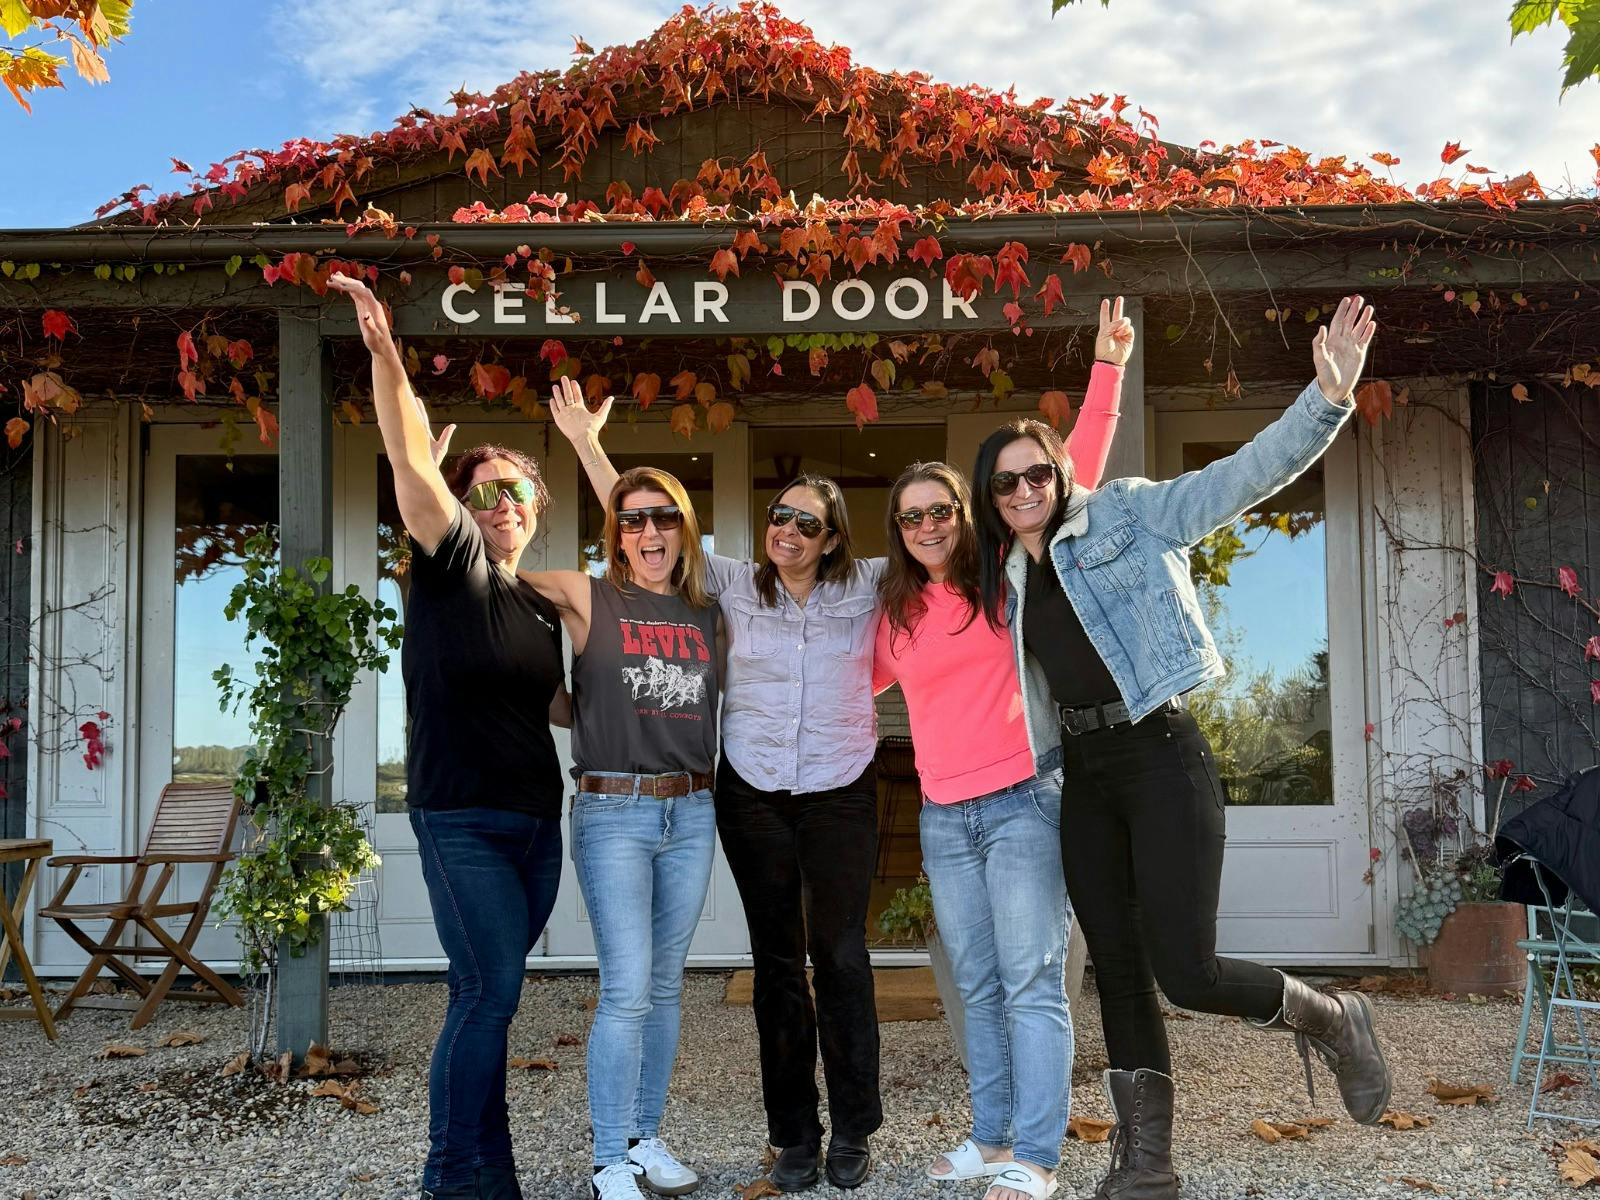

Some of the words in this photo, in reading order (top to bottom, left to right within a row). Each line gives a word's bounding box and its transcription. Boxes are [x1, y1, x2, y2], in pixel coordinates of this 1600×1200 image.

[441, 281, 730, 324] CELLAR
[783, 277, 979, 322] DOOR
[620, 623, 711, 662] LEVI'S
